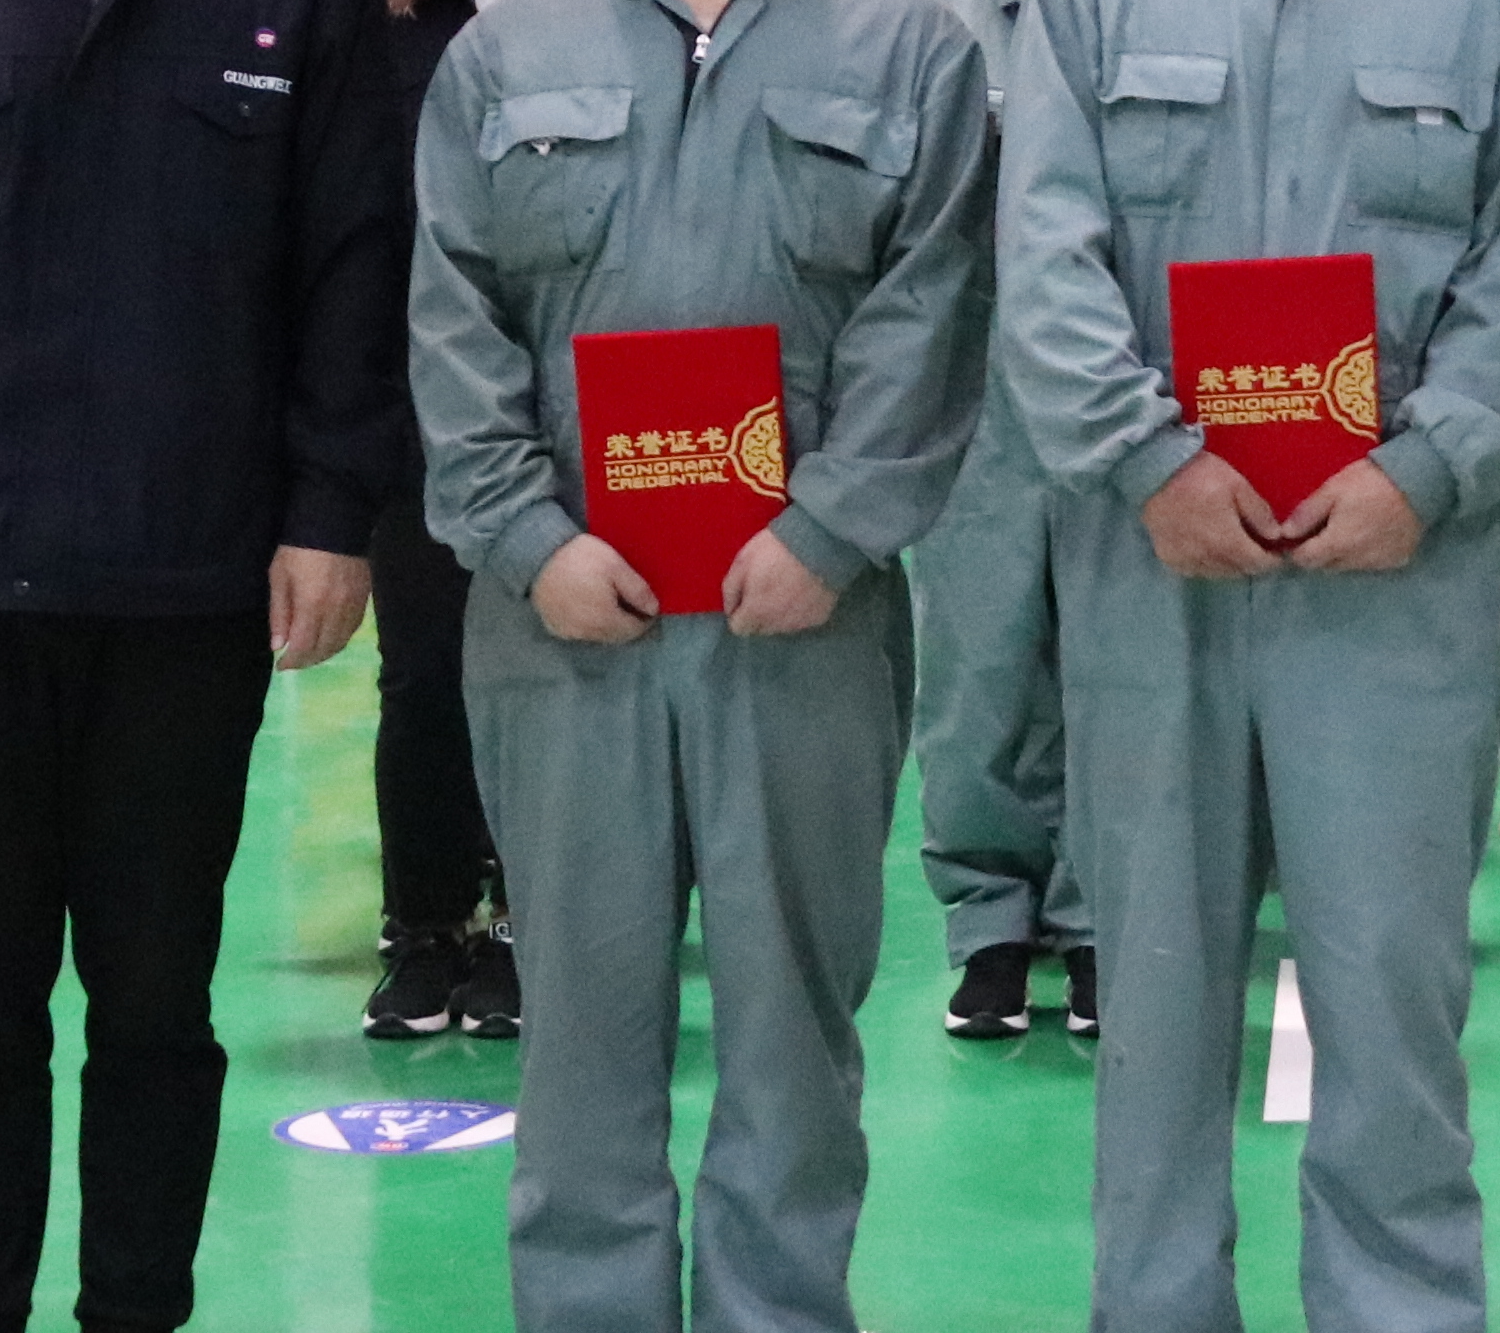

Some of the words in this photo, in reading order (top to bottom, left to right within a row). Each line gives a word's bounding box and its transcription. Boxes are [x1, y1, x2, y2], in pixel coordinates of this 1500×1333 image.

[222, 69, 294, 95] GUANGWEI
[1196, 363, 1322, 393] 荣誉证书
[1196, 395, 1321, 414] HONORARY
[1197, 409, 1322, 426] CREDENTIAL
[603, 426, 730, 459] 荣誉证书
[605, 457, 729, 480] HONORARY
[606, 470, 730, 492] CREDENTIAL
